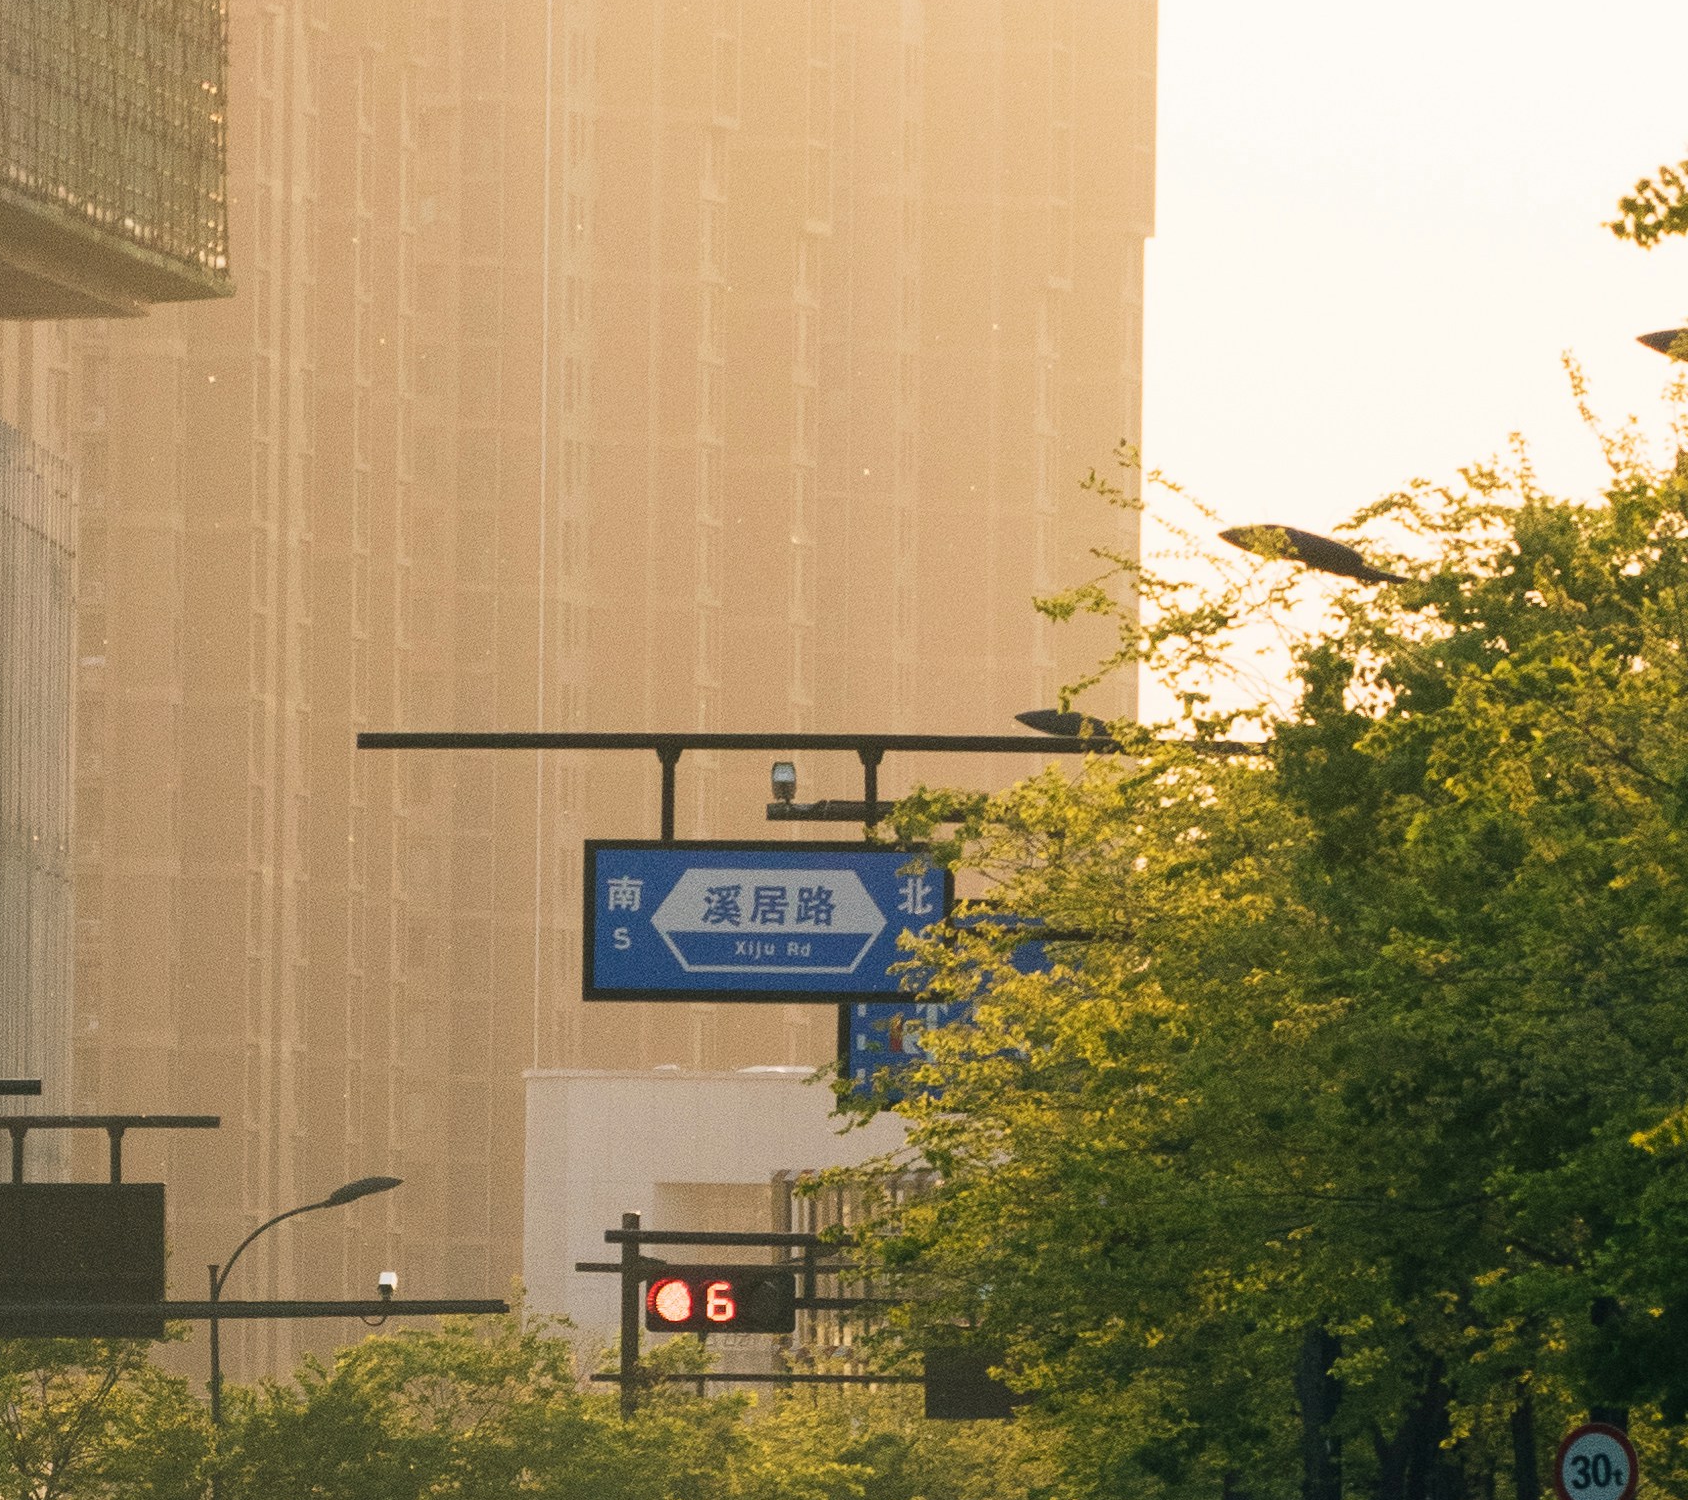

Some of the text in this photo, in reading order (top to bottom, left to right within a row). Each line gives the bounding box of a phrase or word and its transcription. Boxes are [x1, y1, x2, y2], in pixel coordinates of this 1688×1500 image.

[606, 875, 644, 913] 南
[701, 884, 837, 928] 溪居路
[897, 878, 933, 915] 北
[613, 927, 632, 951] S
[734, 940, 813, 961] Xiju Rd
[705, 1280, 737, 1322] 6
[1571, 1453, 1625, 1490] 30t
